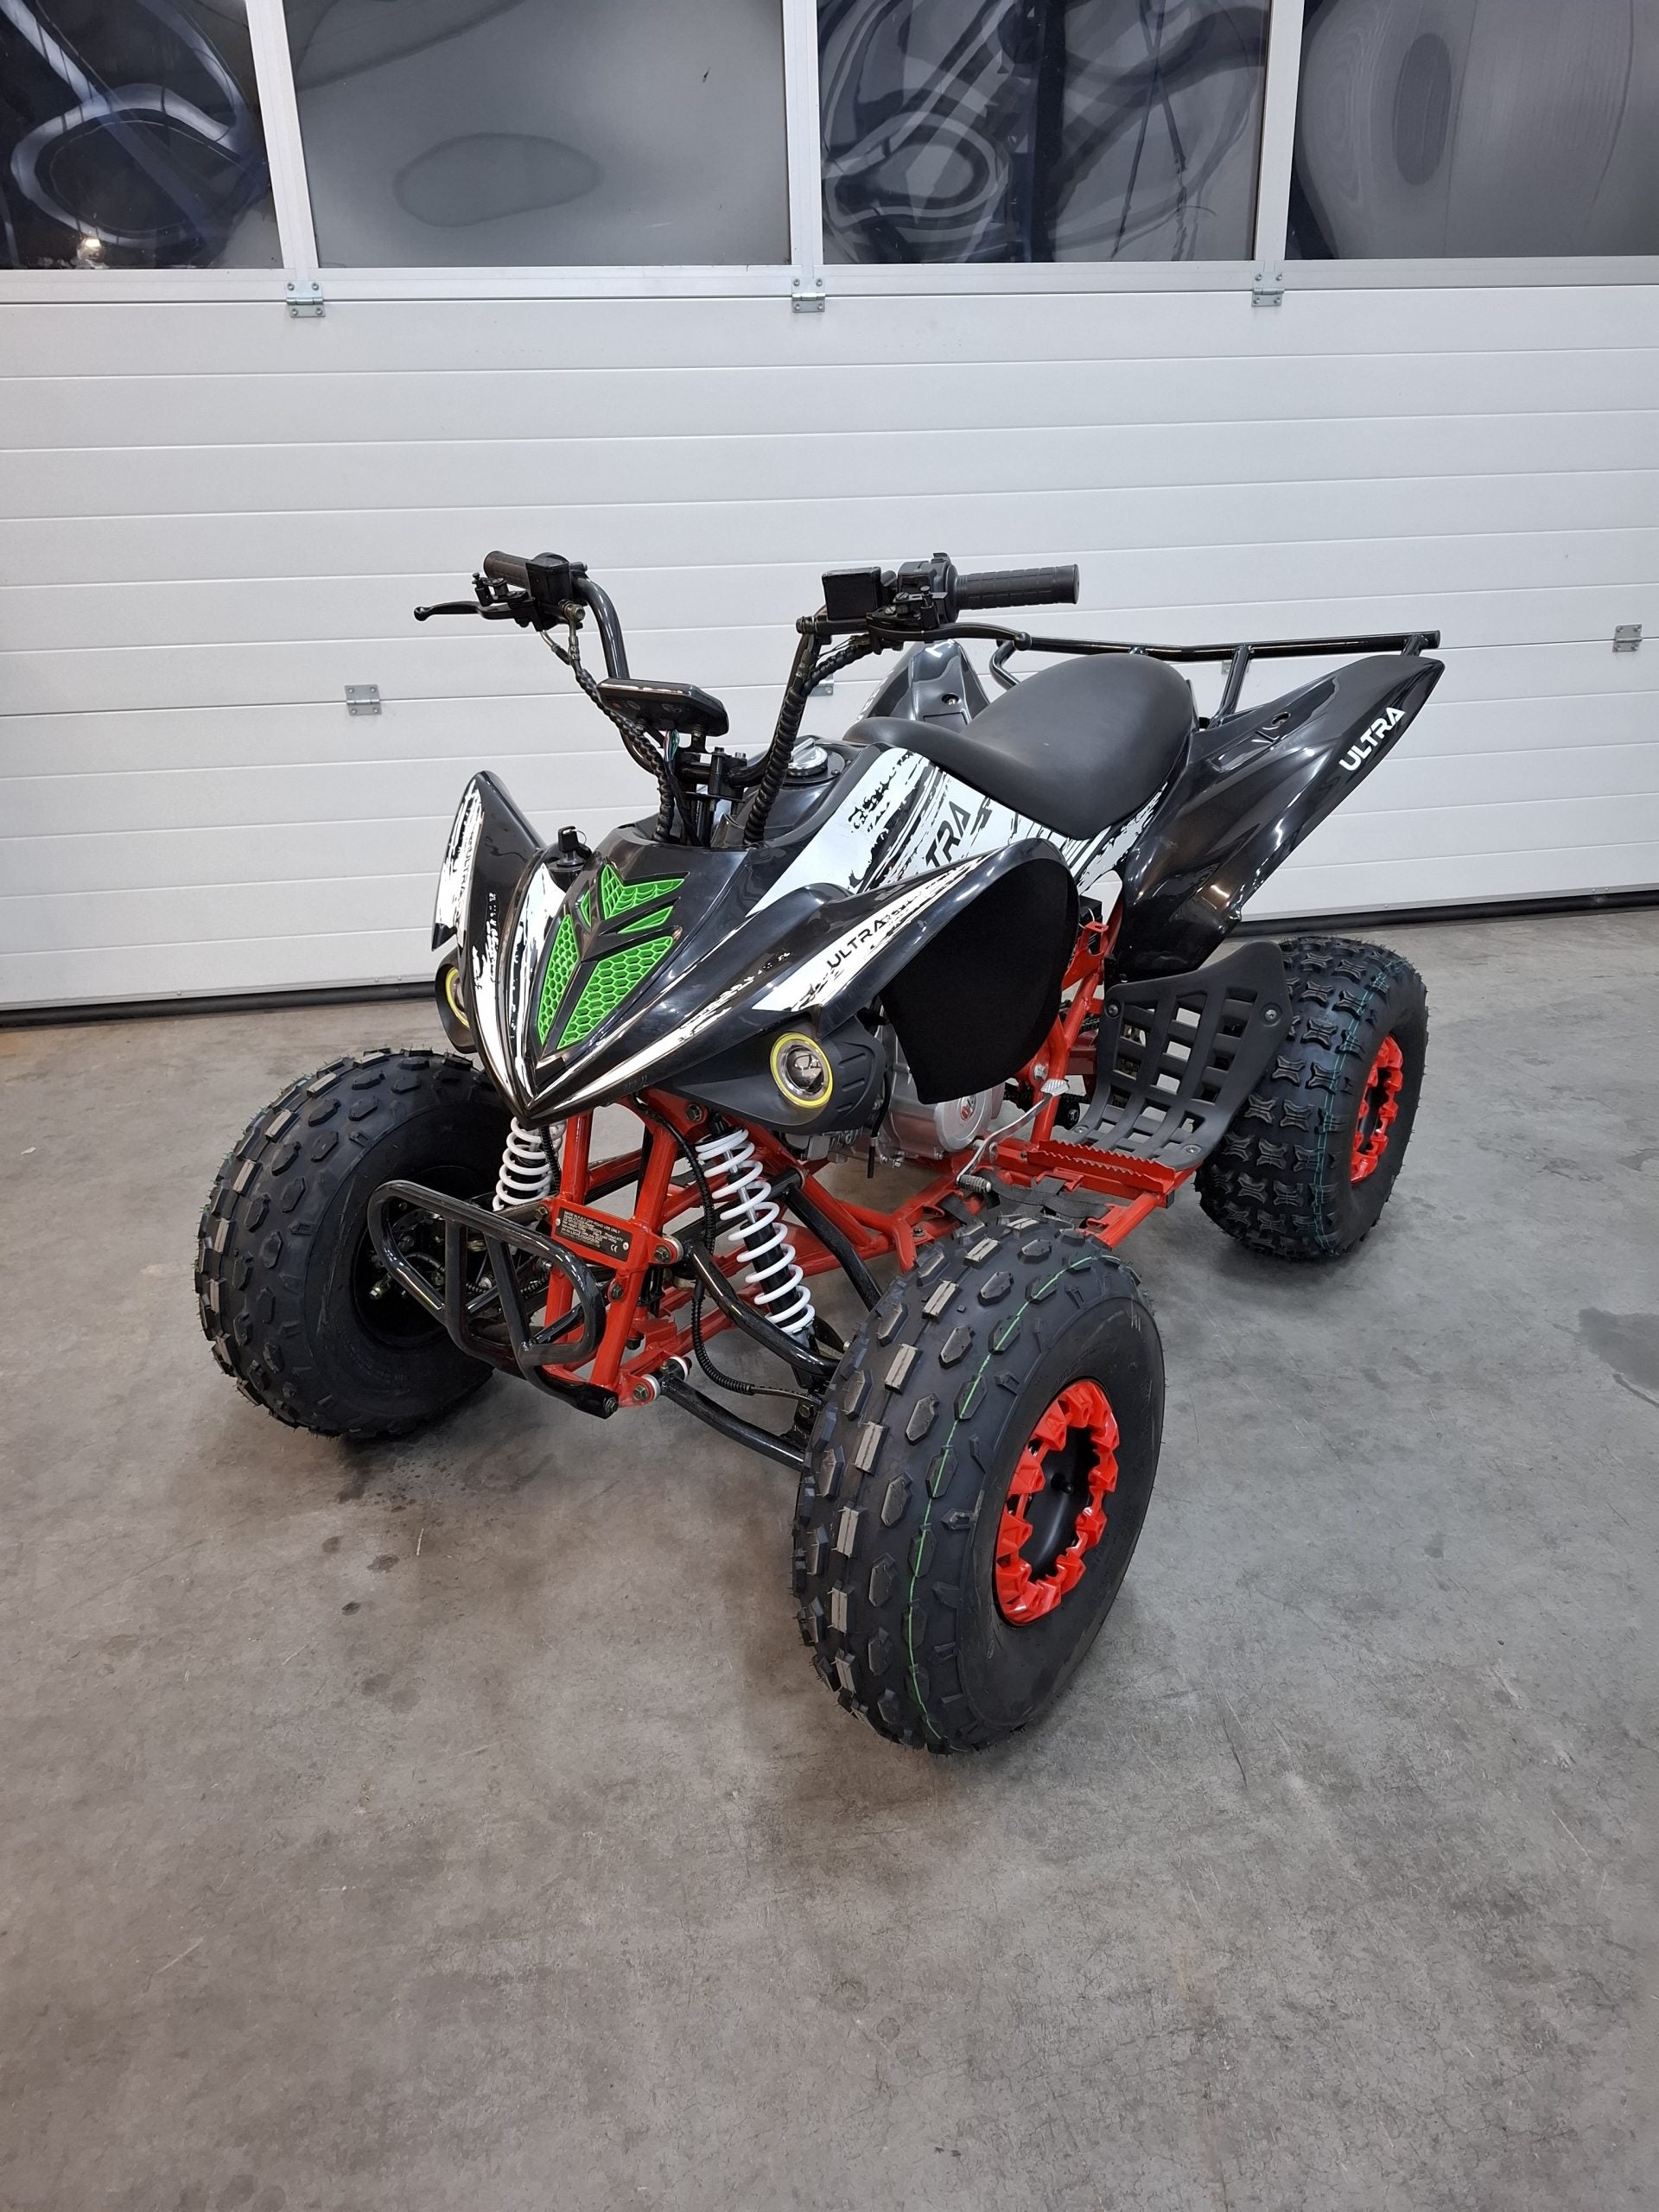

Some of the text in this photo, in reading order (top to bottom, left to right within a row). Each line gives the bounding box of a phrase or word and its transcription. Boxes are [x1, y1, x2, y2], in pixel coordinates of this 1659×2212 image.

[1338, 707, 1406, 771] ULTRA
[925, 801, 971, 868] TRA
[826, 918, 887, 969] ULTRA
